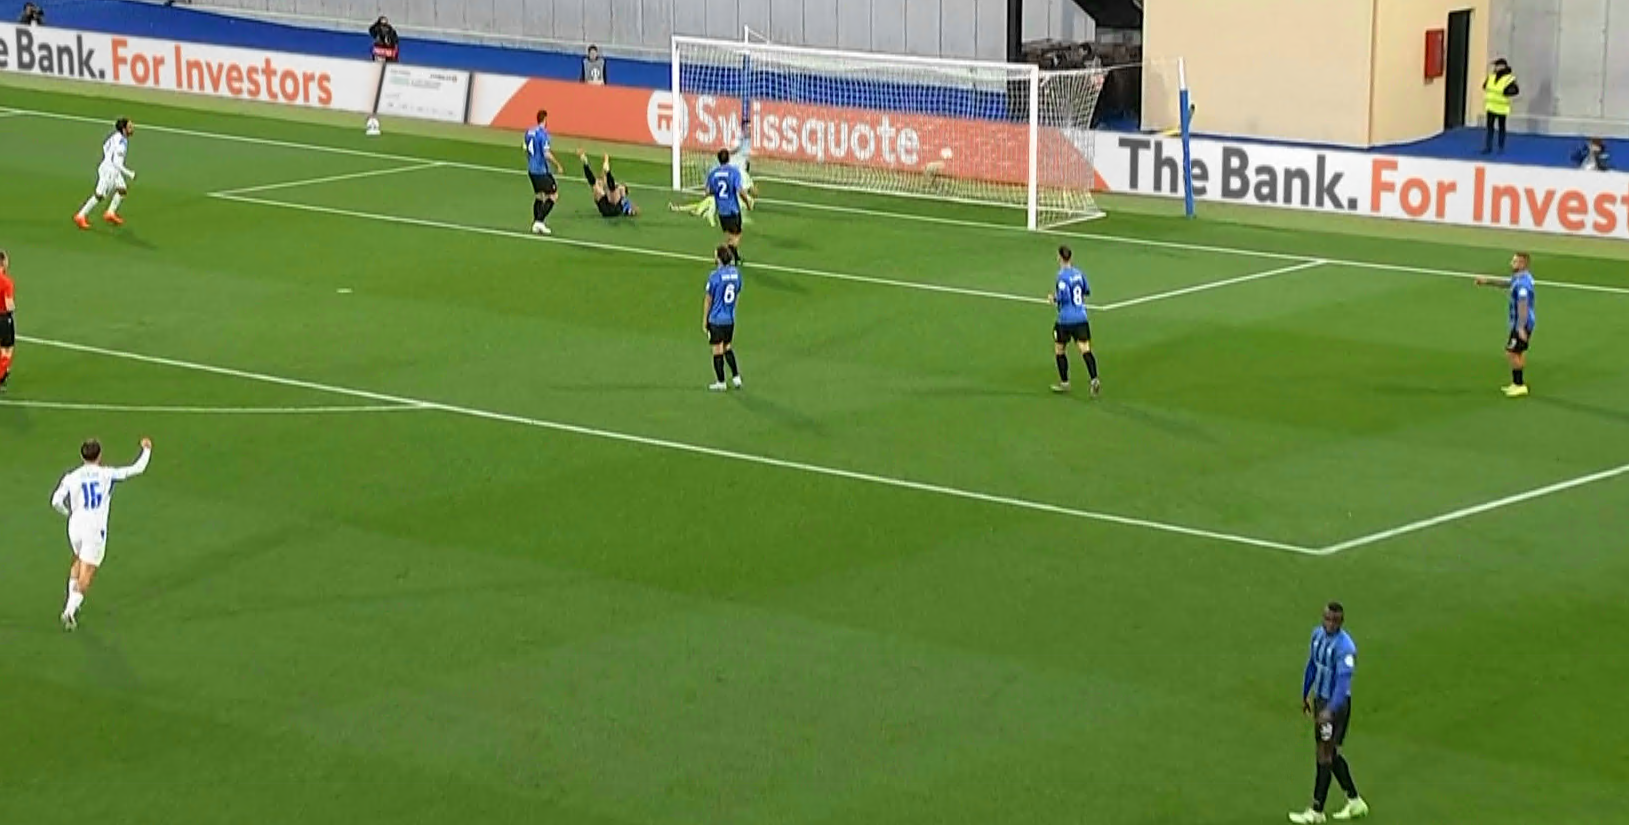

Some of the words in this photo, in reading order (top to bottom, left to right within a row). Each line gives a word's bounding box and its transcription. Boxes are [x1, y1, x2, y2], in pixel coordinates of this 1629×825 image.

[16, 28, 106, 79] Bank.
[111, 37, 165, 89] For
[174, 44, 333, 105] Investors
[695, 95, 920, 165] Swissquote
[527, 139, 535, 156] 4
[717, 179, 729, 198] 2
[1118, 136, 1210, 197] The
[1221, 145, 1359, 211] Bank.
[1371, 157, 1459, 220] For
[724, 283, 735, 304] 6
[1073, 285, 1083, 306] 8
